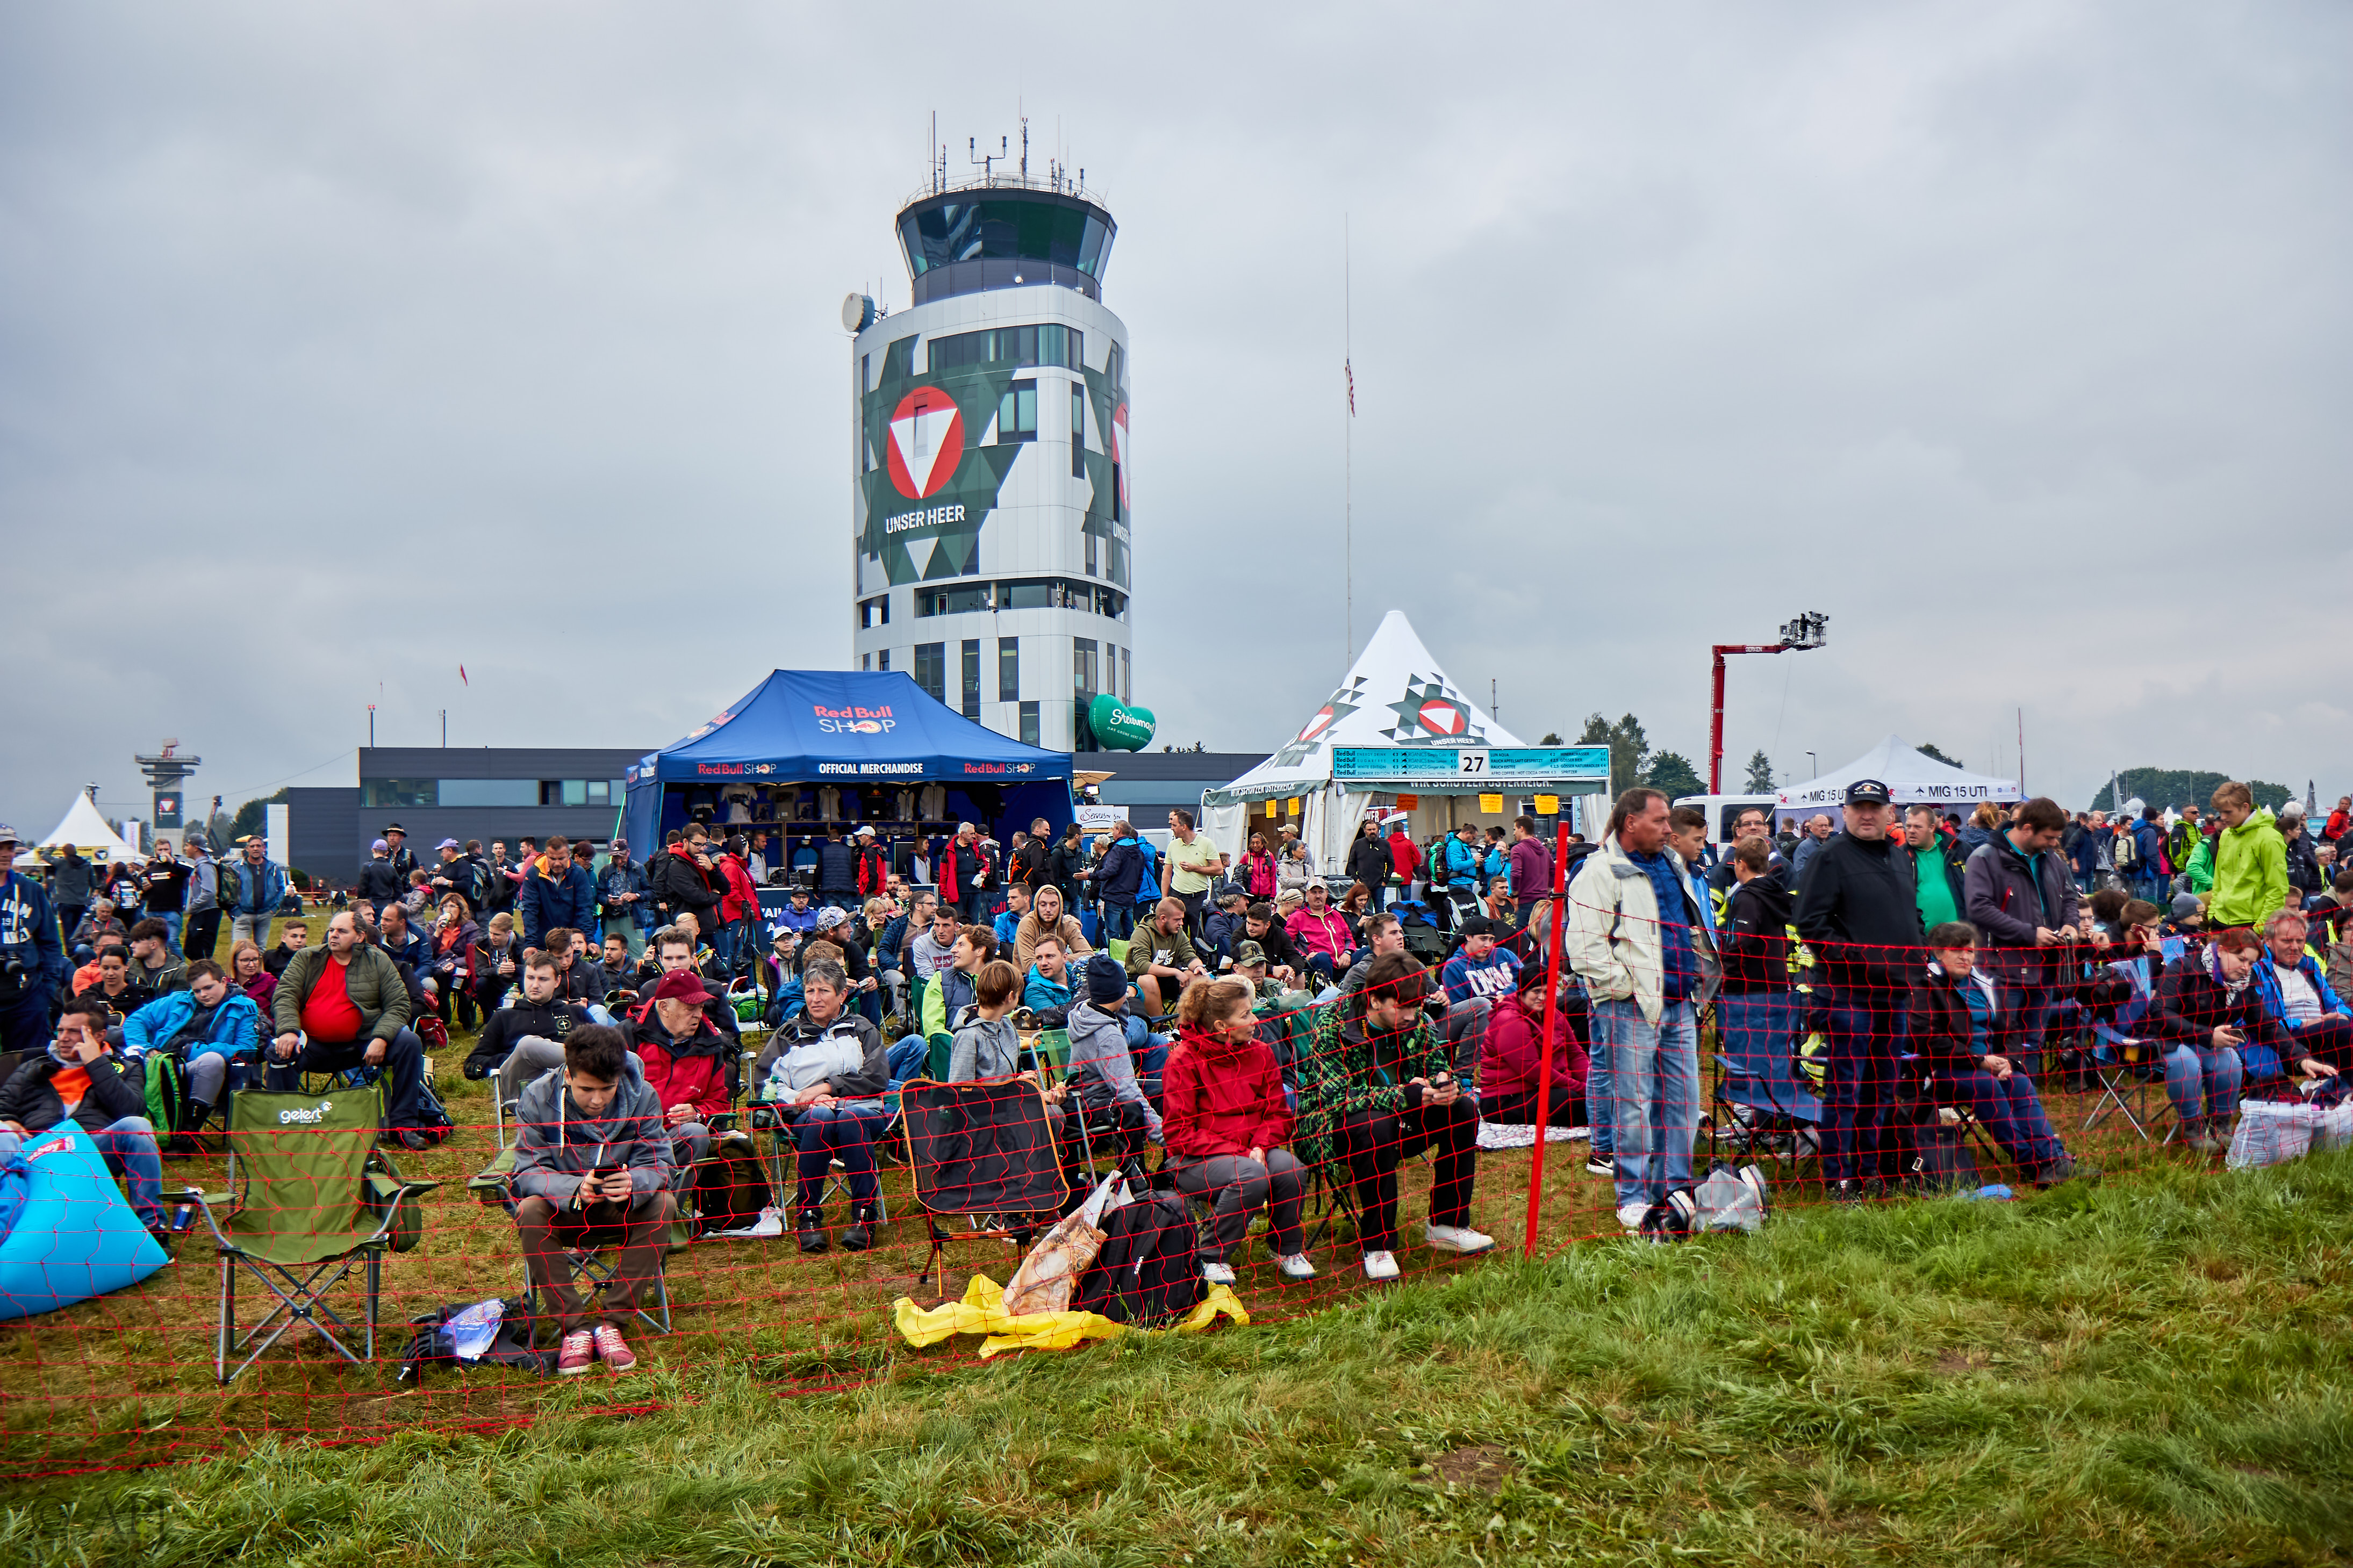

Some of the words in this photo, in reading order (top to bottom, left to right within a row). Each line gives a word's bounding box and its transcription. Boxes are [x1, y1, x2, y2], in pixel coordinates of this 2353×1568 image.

[885, 511, 925, 534] UNSER
[927, 505, 965, 525] HEER
[813, 706, 853, 718] Red
[855, 706, 893, 718] Bull
[819, 719, 896, 733] SHOP
[1430, 738, 1455, 746] UNSER
[698, 763, 720, 774] Red
[722, 763, 743, 774] Bull
[744, 764, 777, 774] SHOP
[819, 764, 858, 774] OFFICIAL
[860, 763, 923, 774] MERCHANDISE
[964, 763, 985, 773] Red
[986, 763, 1005, 773] Bull
[1006, 763, 1035, 773] SHOP
[1463, 757, 1484, 772] 27
[1810, 790, 1825, 802] MIG
[1827, 790, 1836, 801] 15
[1838, 789, 1847, 800] U
[1928, 786, 1951, 797] MIG
[1954, 786, 1967, 797] 15
[1969, 786, 1988, 797] UTI
[1163, 957, 1174, 966] SB
[280, 1107, 322, 1124] gelert
